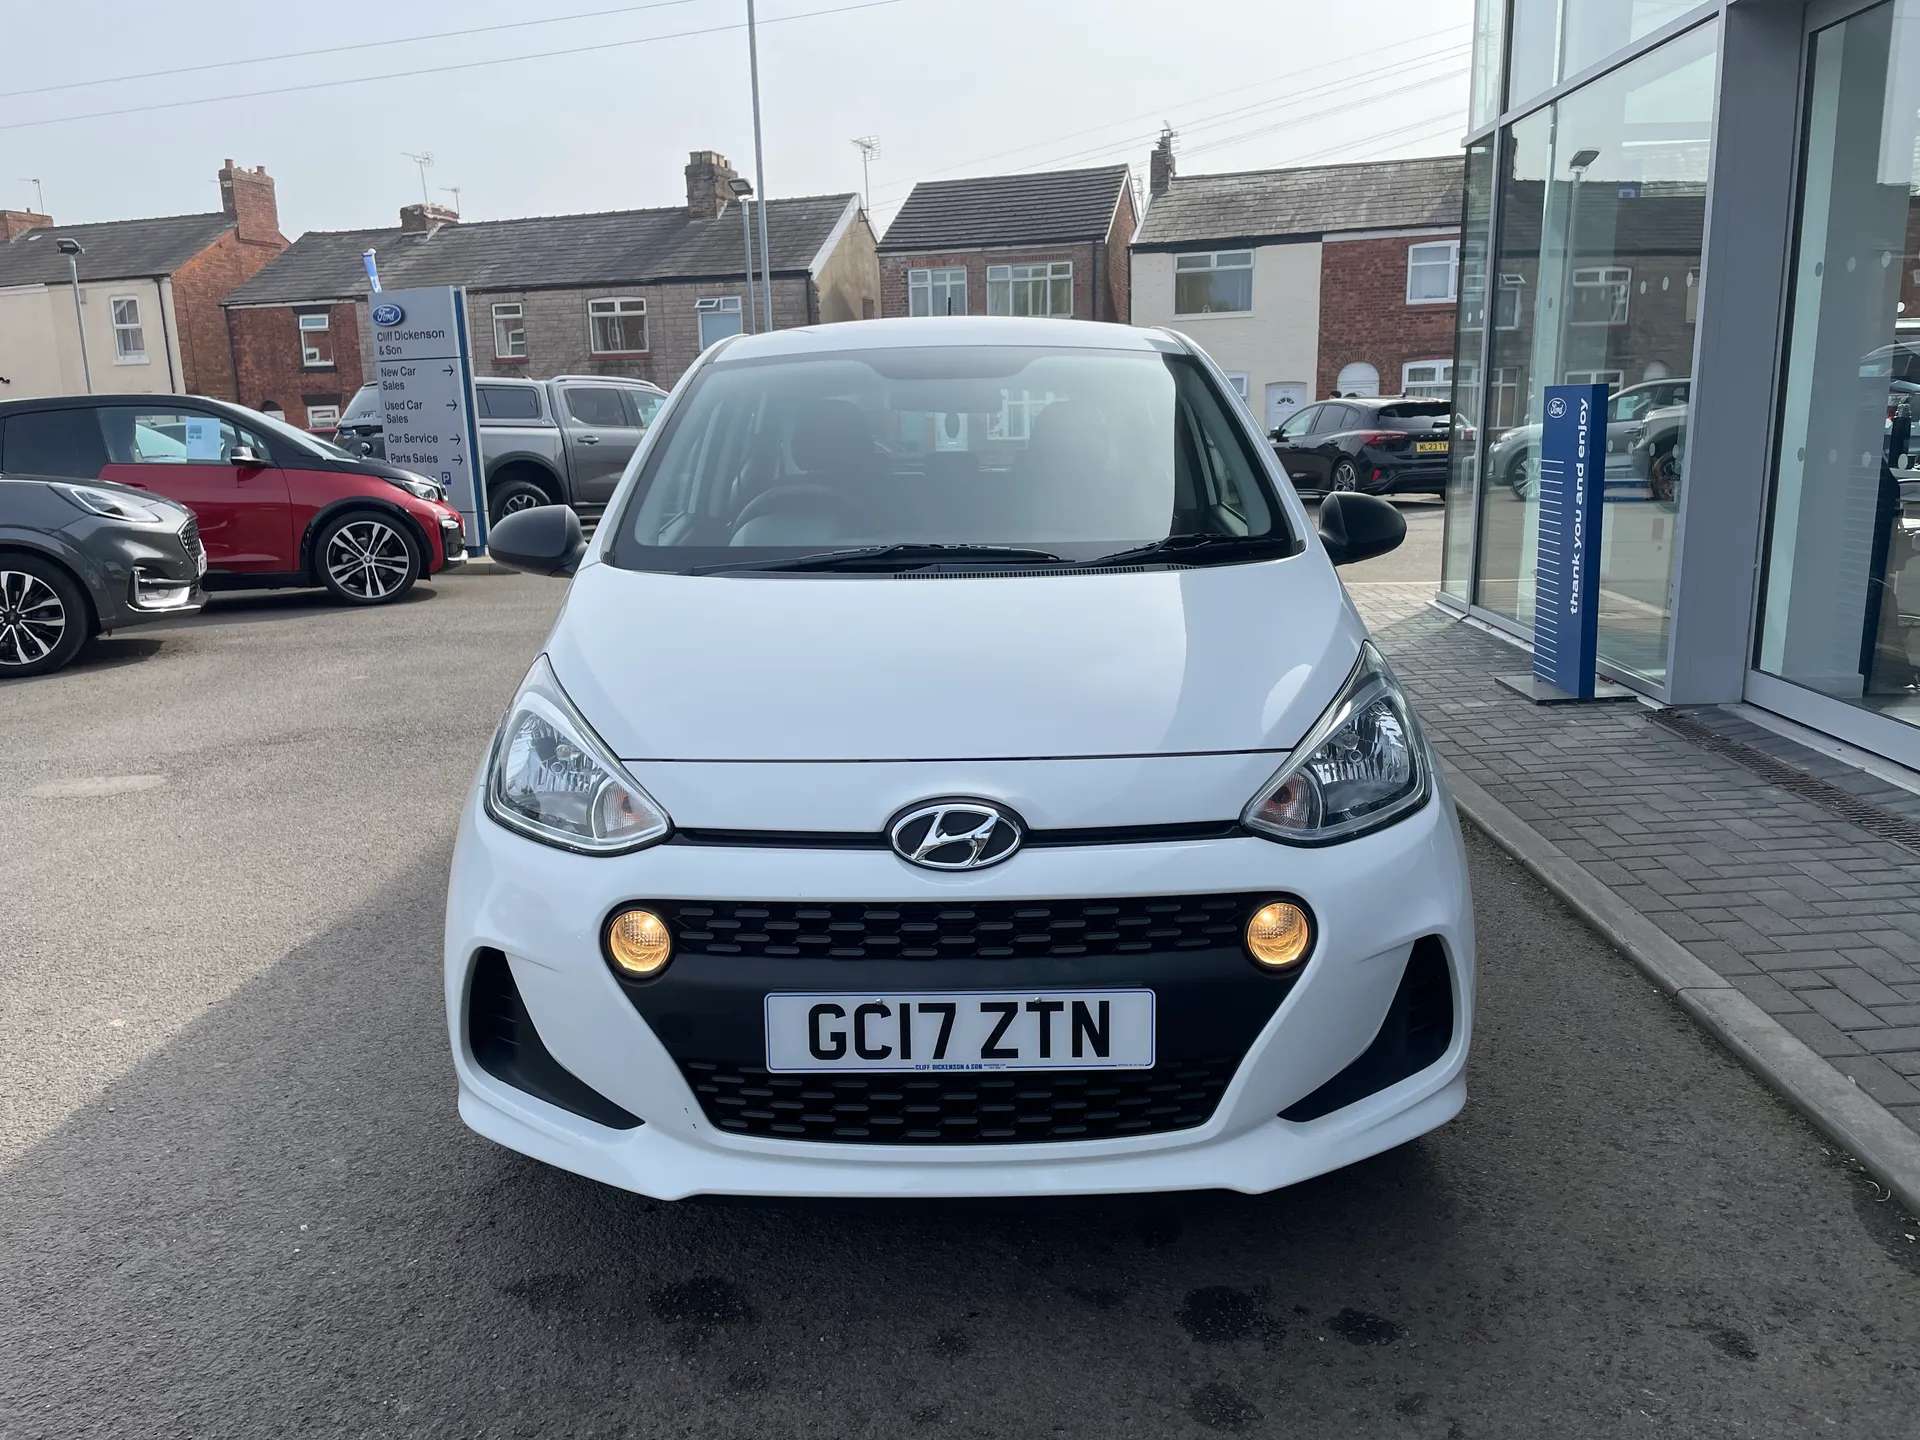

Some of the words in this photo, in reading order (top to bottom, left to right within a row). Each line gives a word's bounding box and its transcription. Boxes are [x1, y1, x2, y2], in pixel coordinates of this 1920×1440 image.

[377, 307, 395, 322] Ford
[376, 331, 393, 342] Cliff
[394, 329, 445, 341] Dickenson
[379, 346, 385, 355] &
[385, 345, 402, 355] Son
[381, 367, 399, 377] New
[400, 366, 416, 376] Car
[382, 380, 405, 391] Sales
[384, 400, 405, 411] Used
[406, 400, 423, 410] Car
[1550, 400, 1564, 414] Ford
[386, 413, 409, 424] Sales
[1578, 398, 1588, 458] enjoy
[388, 433, 402, 443] Car
[403, 432, 439, 443] Service
[390, 453, 411, 463] Parts
[412, 453, 439, 463] Sales
[1576, 463, 1584, 505] and
[1574, 509, 1582, 549] you
[1570, 553, 1580, 615] thank
[808, 1002, 957, 1060] GC17
[980, 1000, 1110, 1059] ZTN
